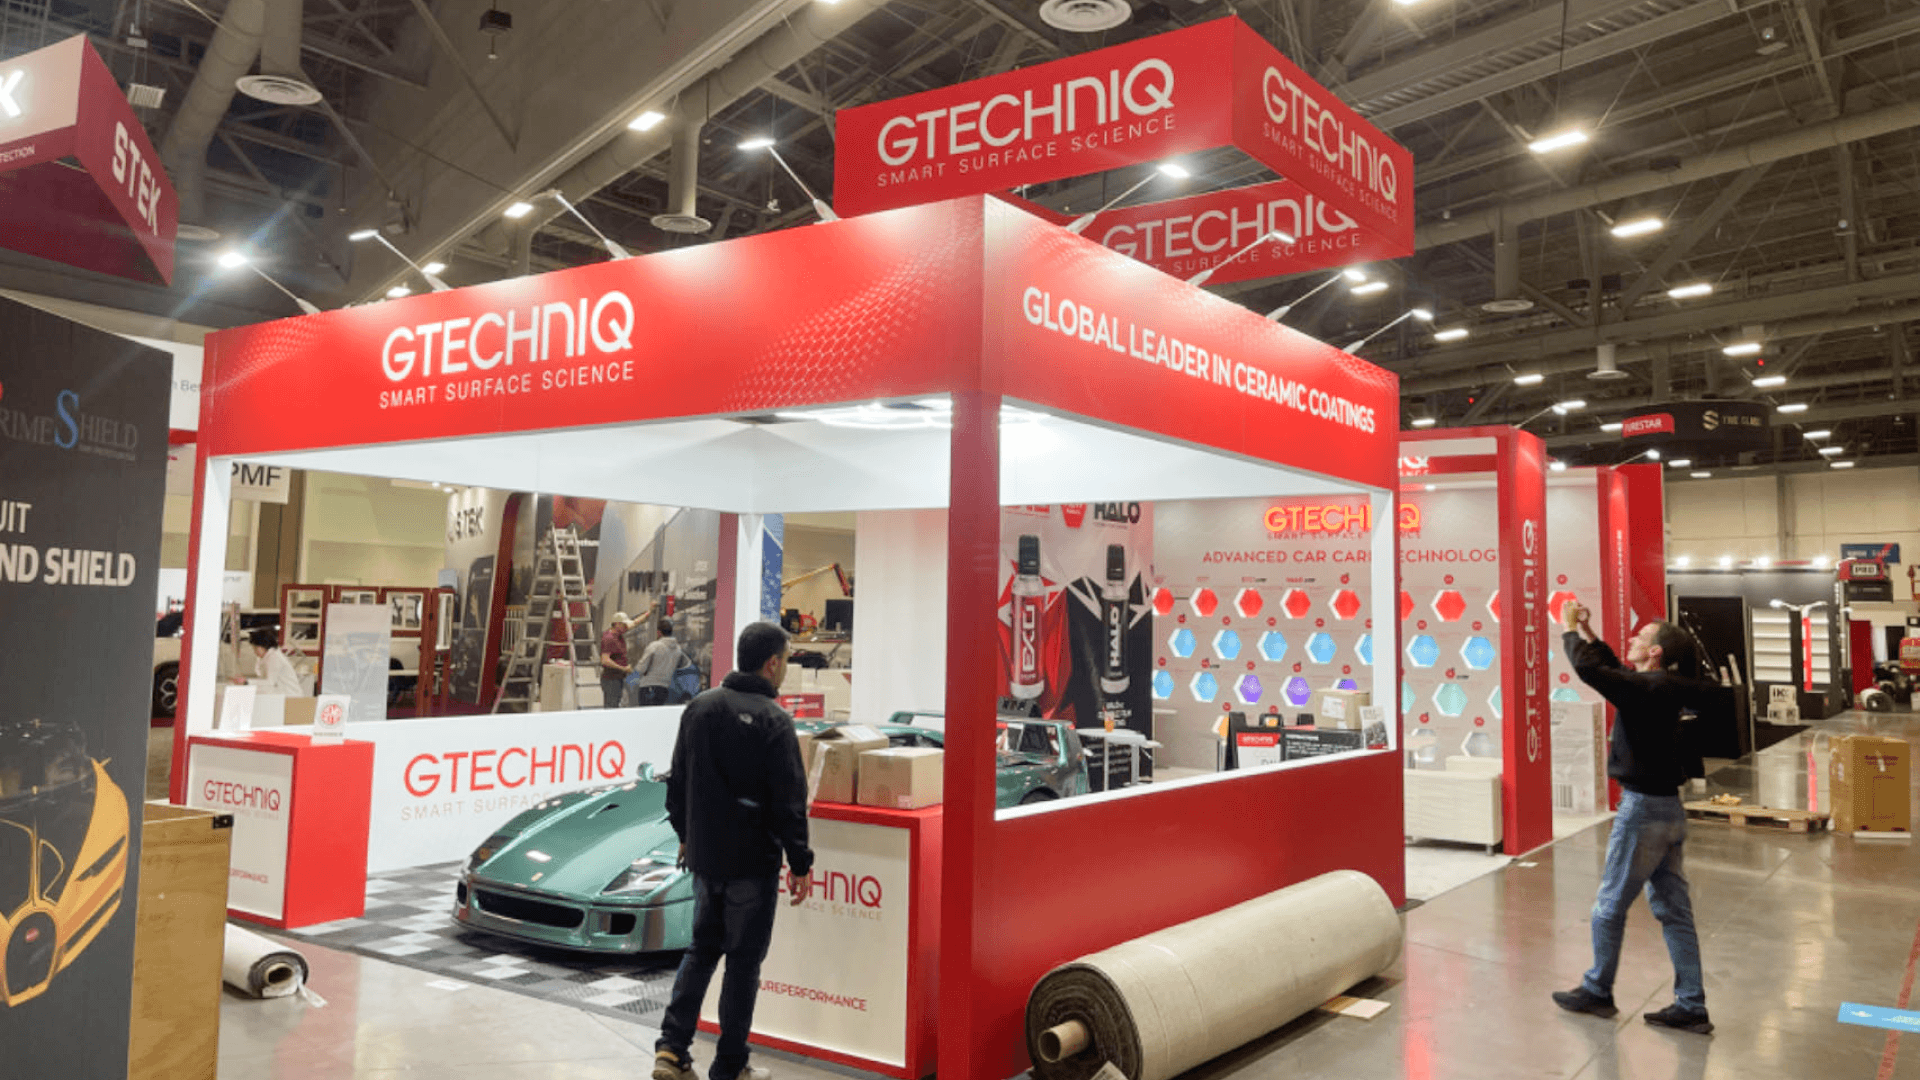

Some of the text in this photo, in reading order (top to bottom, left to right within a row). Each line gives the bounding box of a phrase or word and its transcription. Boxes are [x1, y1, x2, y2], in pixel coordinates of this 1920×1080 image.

[878, 58, 1174, 166] GTECHNIQ
[1263, 66, 1397, 204] GTECHNIQ
[112, 121, 161, 236] STEK
[877, 113, 1176, 187] SMART SURFACE SCIENCE
[382, 290, 635, 381] GTECHNIQ
[1023, 287, 1376, 434] GLOBAL LEADER IN CERAMIC COATINGS
[379, 360, 635, 409] SMART SURFACE SCIENCE
[457, 507, 483, 539] STEK
[1094, 502, 1140, 524] HALO
[44, 547, 136, 587] SHIELD
[1203, 550, 1288, 564] ADVANCED
[1292, 550, 1327, 563] CAR
[1109, 605, 1121, 668] HALO
[1523, 519, 1538, 763] GTECHNIQ
[204, 780, 281, 811] GTECHNIQ
[403, 740, 625, 797] GTECHNIQ
[400, 801, 463, 821] SMART
